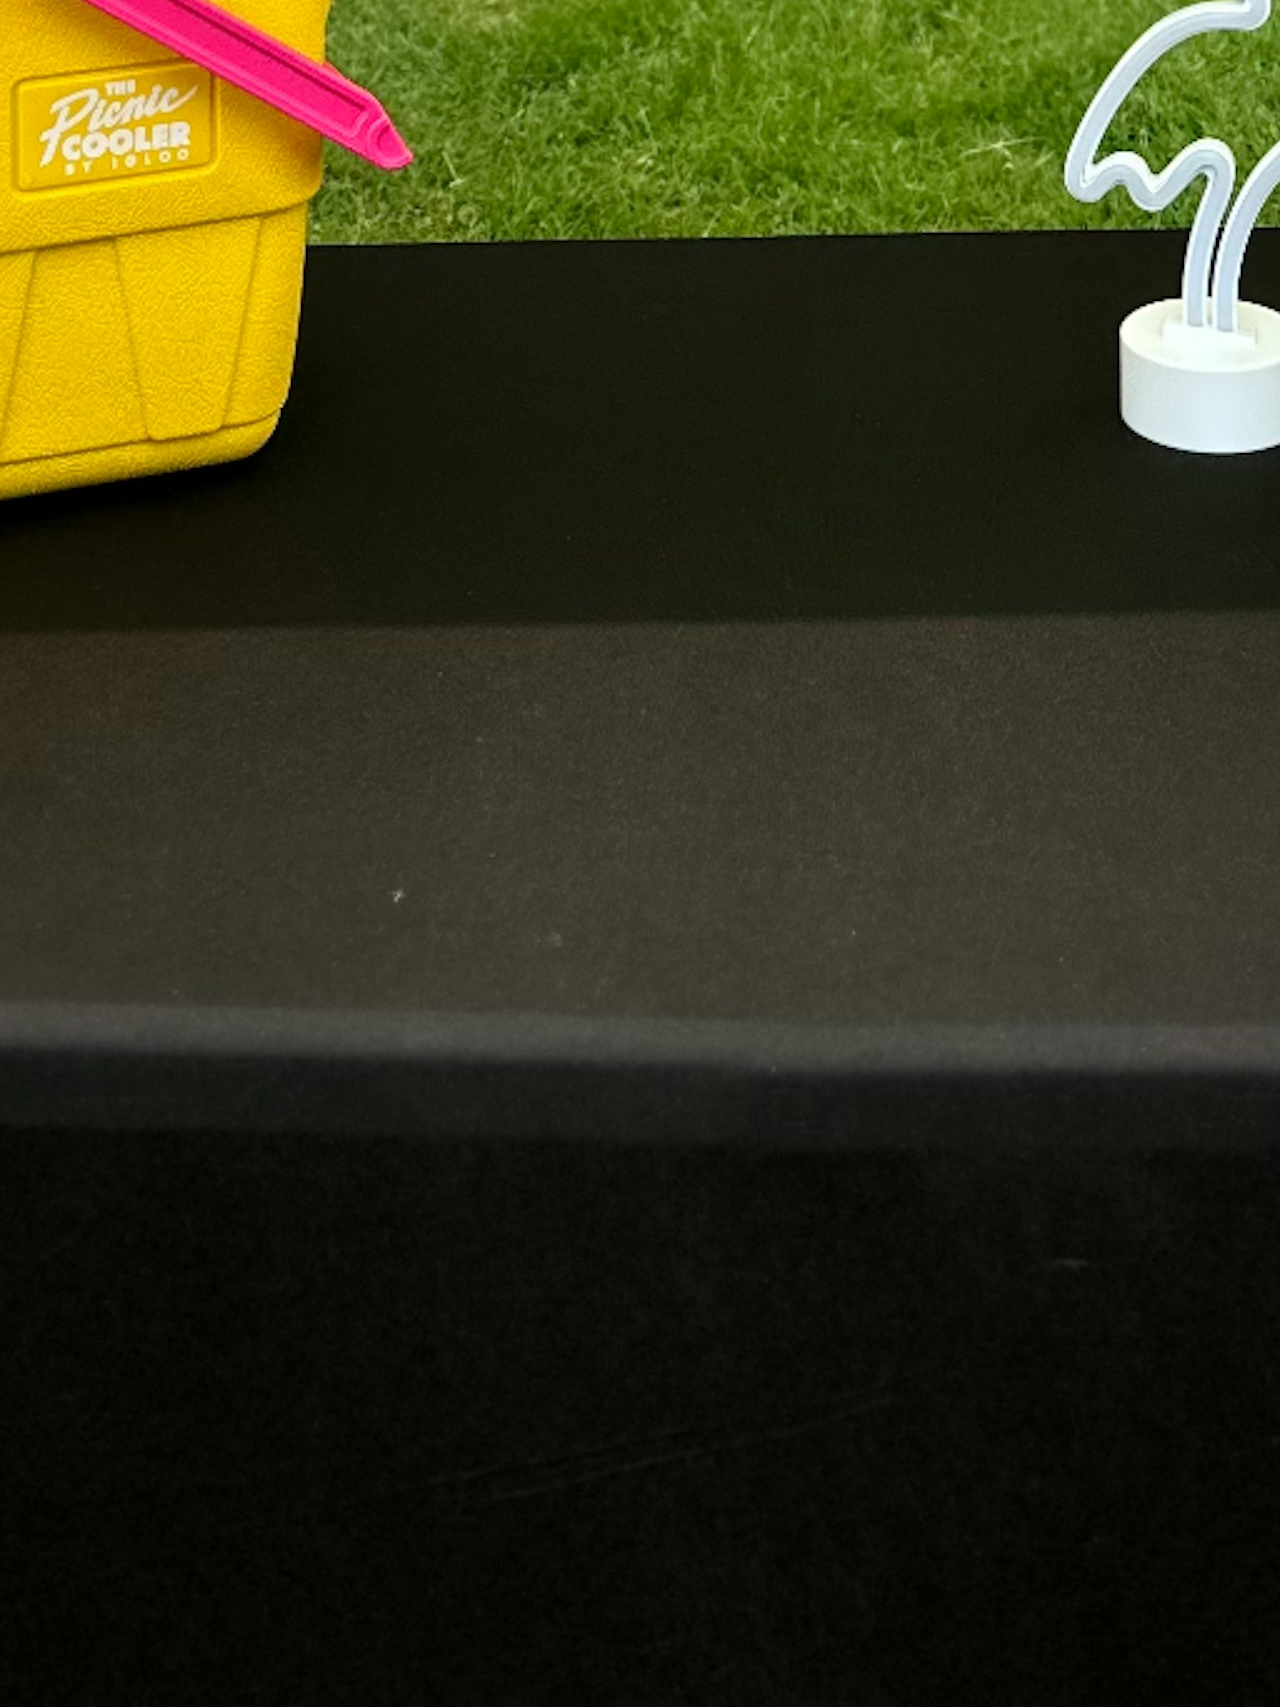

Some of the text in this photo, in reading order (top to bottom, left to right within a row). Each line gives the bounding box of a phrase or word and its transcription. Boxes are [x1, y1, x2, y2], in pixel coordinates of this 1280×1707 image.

[104, 79, 136, 96] THE
[40, 85, 199, 168] Picnic
[62, 121, 192, 161] COOLER
